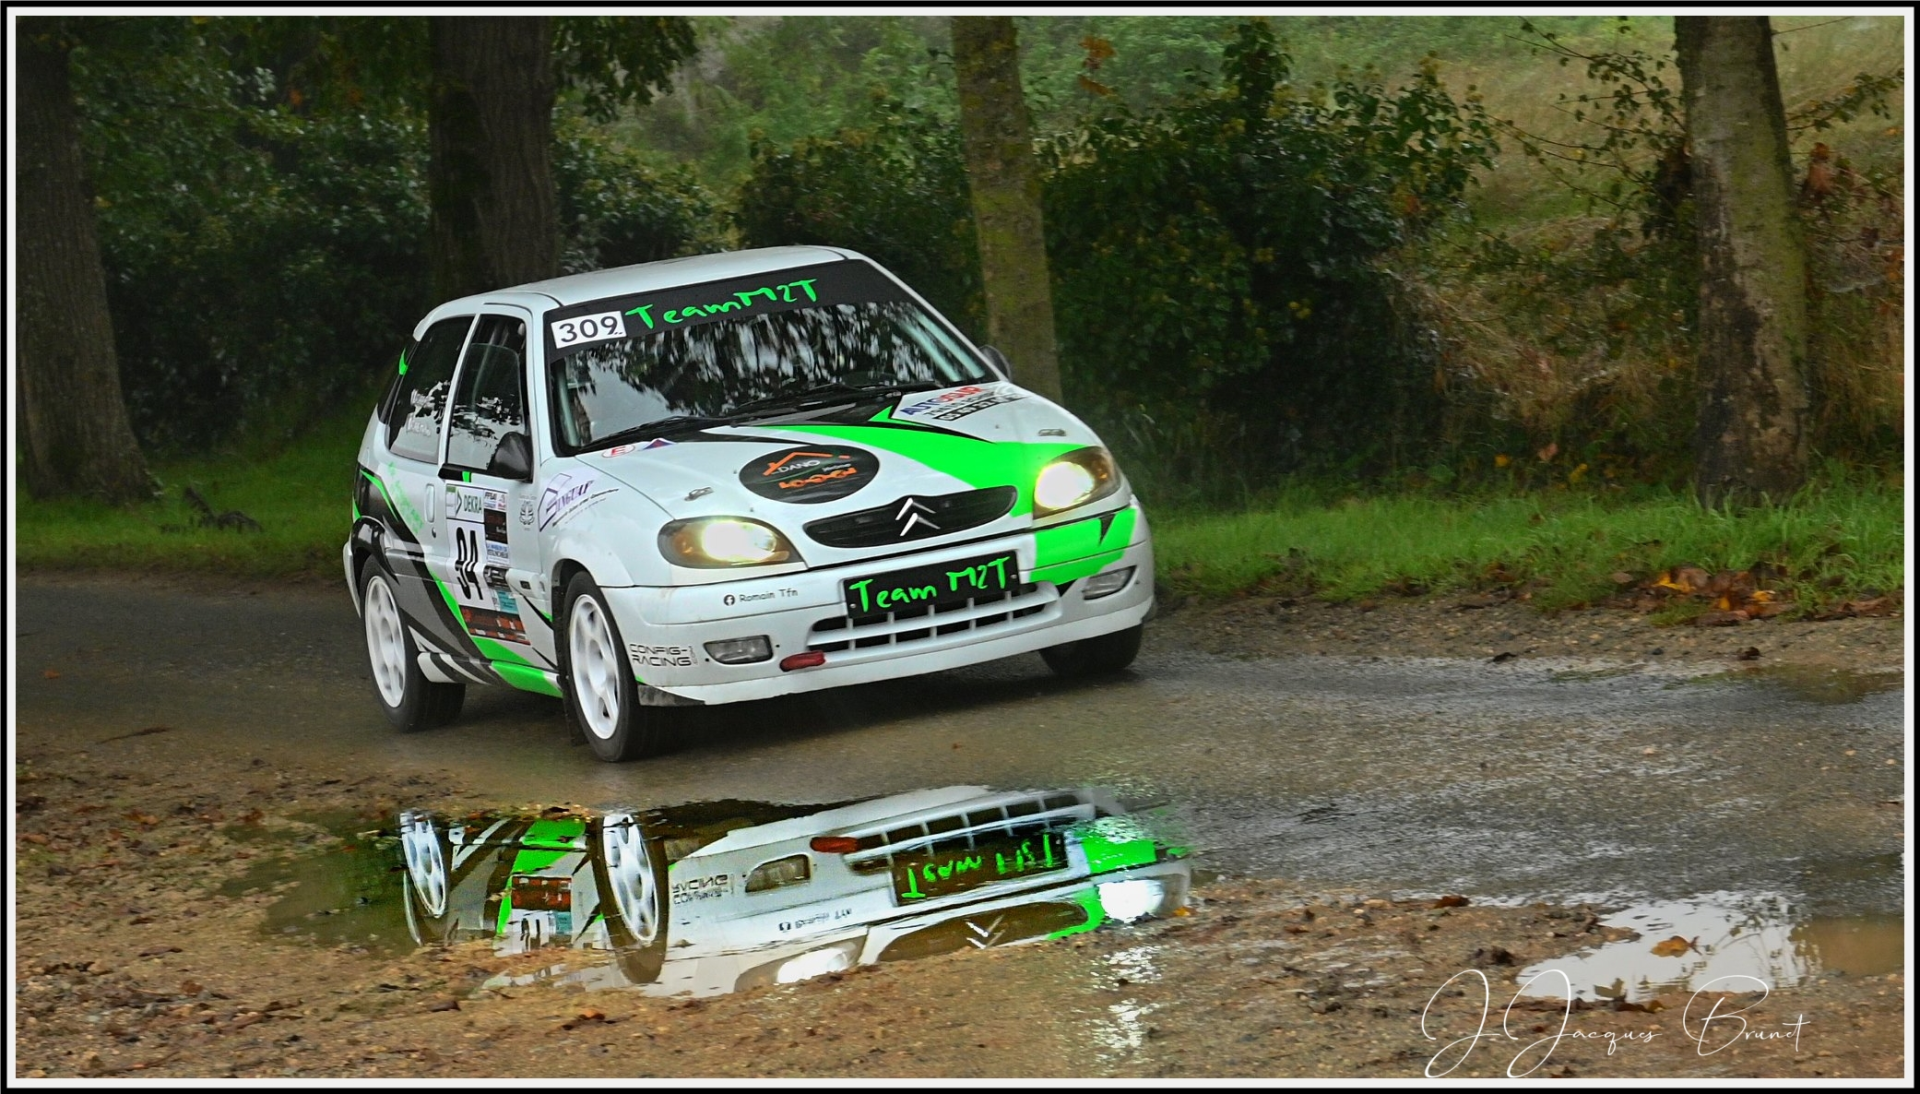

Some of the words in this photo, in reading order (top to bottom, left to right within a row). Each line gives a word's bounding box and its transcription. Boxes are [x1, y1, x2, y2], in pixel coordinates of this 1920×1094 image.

[559, 315, 618, 343] 309
[463, 494, 482, 514] DEKRA
[849, 579, 937, 613] Team
[945, 556, 1011, 592] M2T
[739, 592, 775, 602] Romain
[631, 654, 692, 667] RACING
